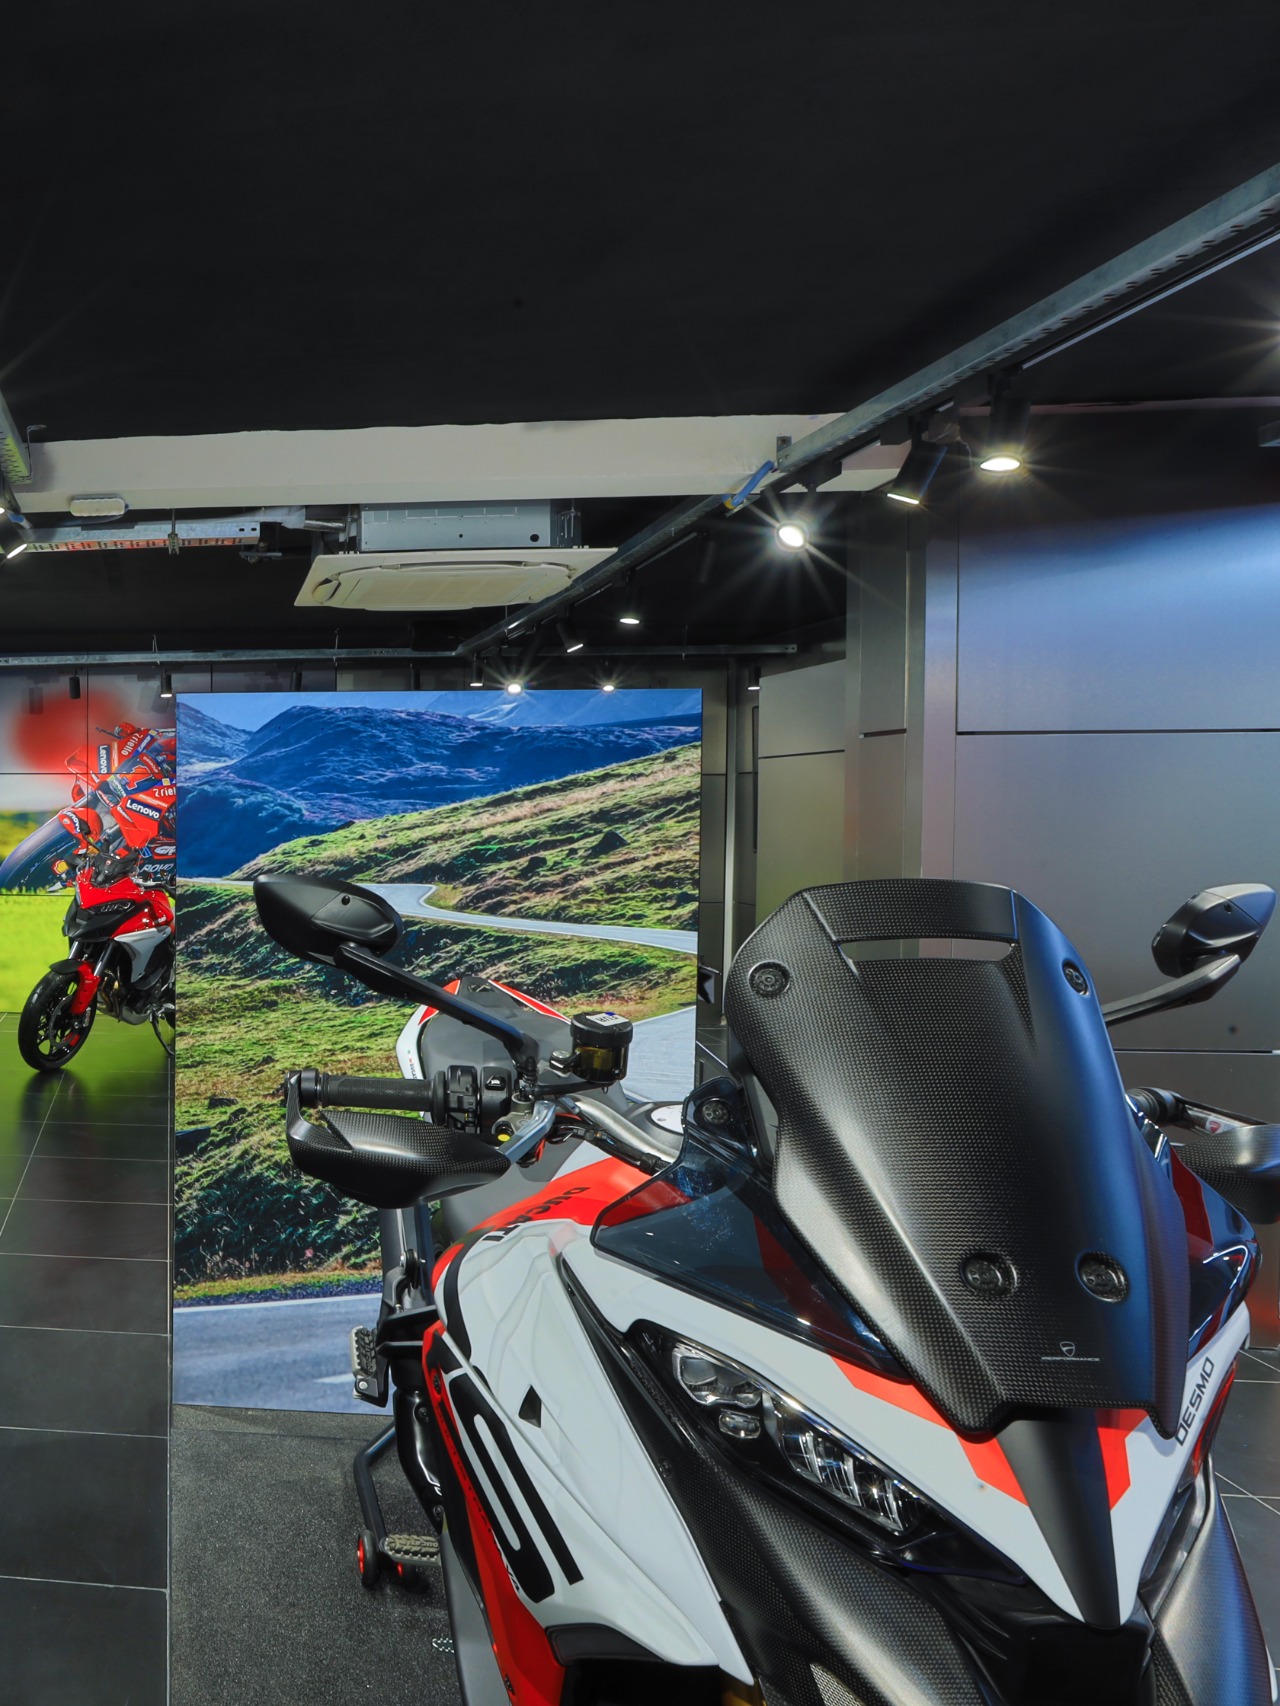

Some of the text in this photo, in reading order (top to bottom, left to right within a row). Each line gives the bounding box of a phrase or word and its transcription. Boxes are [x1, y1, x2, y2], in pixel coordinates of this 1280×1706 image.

[99, 745, 108, 774] Lenovo
[126, 799, 160, 819] Lenovo
[480, 1187, 592, 1242] DUCATI
[1175, 1356, 1215, 1447] DESMO
